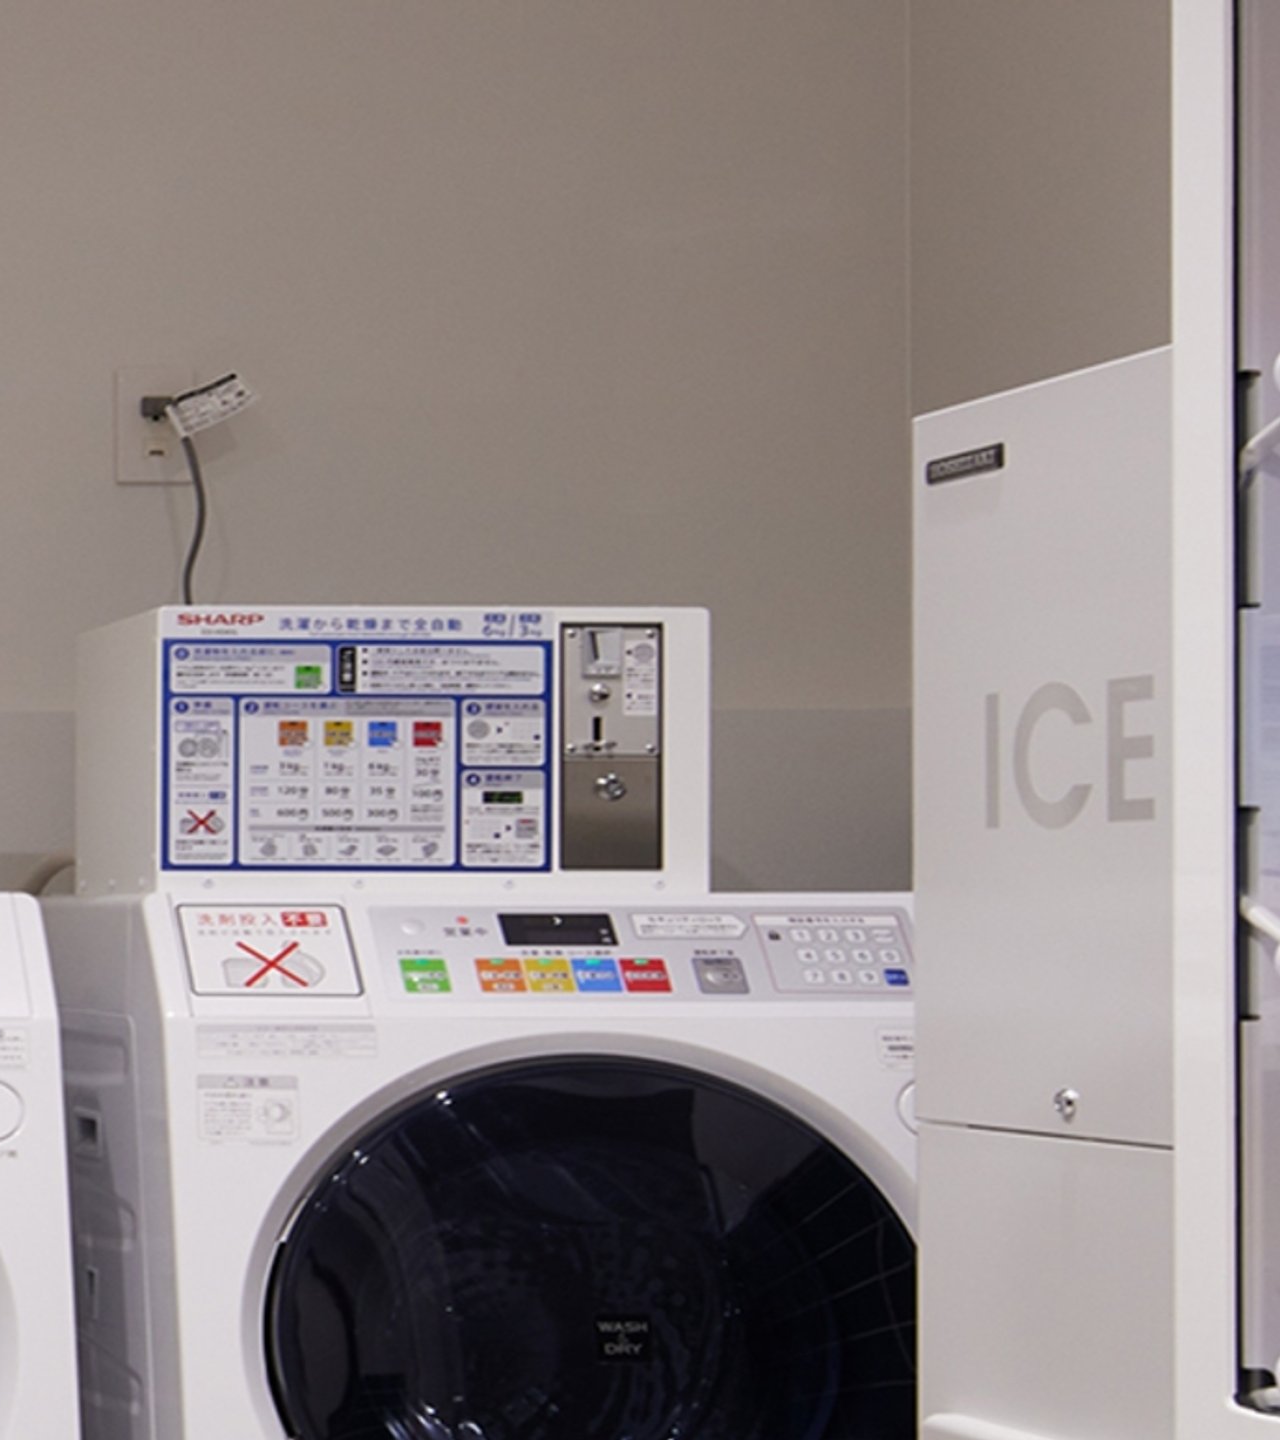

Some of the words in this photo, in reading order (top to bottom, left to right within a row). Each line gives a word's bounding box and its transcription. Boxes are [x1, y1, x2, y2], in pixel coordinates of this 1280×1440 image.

[177, 613, 265, 627] SHARP
[985, 674, 1155, 830] ICE
[596, 1321, 648, 1333] WASH
